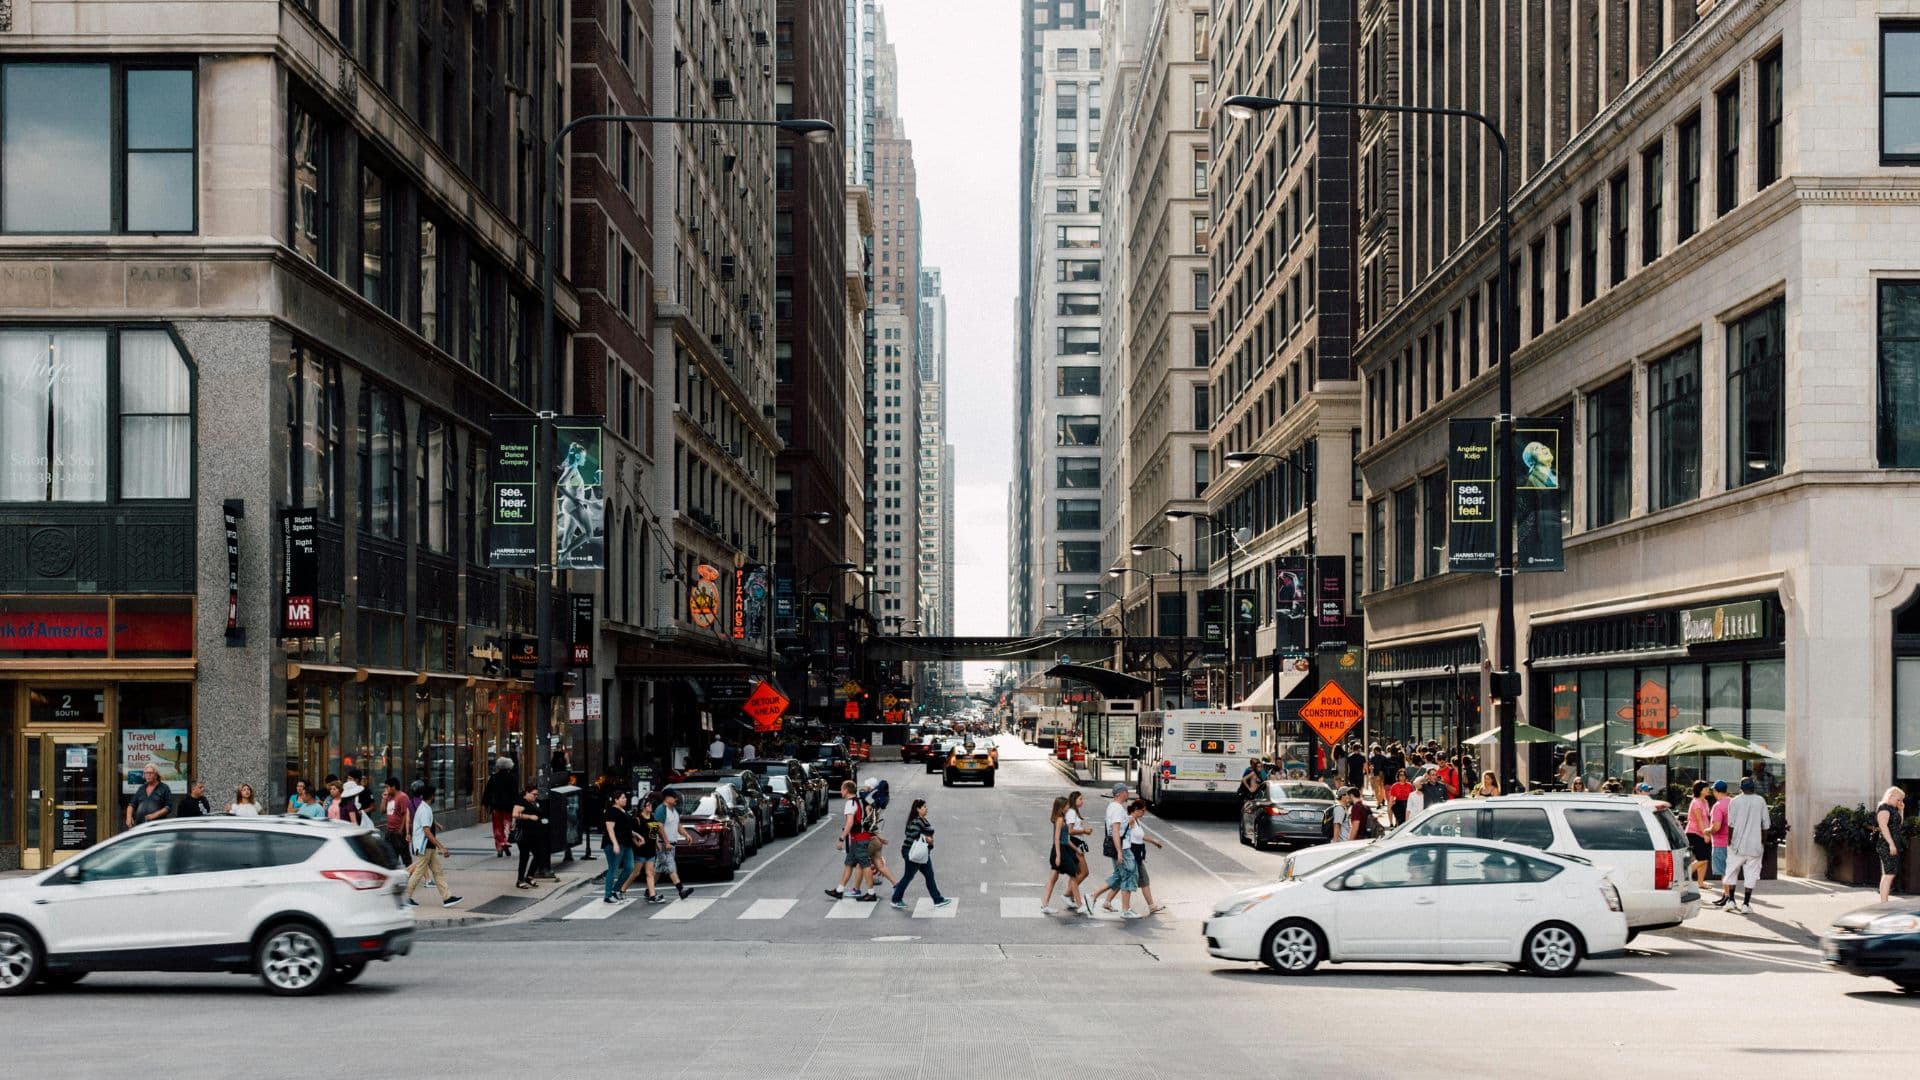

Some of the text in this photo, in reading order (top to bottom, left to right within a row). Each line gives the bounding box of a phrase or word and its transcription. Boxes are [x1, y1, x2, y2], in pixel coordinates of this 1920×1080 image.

[499, 458, 529, 466] Company
[500, 488, 524, 497] see.
[1458, 485, 1482, 494] see.
[500, 497, 527, 507] hear.
[1458, 495, 1486, 505] hear.
[500, 508, 524, 519] feel.
[1458, 506, 1482, 516] feel.
[294, 516, 313, 525] Right
[292, 524, 315, 532] Space.
[288, 605, 310, 620] MR
[18, 622, 34, 638] of
[37, 622, 104, 638] America
[575, 649, 588, 658] MR
[62, 694, 72, 709] 2
[751, 695, 780, 706] DETOUR
[1321, 697, 1342, 705] ROAD
[754, 706, 780, 715] AHEAD
[1304, 709, 1359, 717] CONSTRUCTION
[1319, 721, 1345, 729] AHEAD
[128, 731, 156, 741] Travel
[128, 743, 165, 751] without
[1207, 742, 1217, 750] 20
[128, 752, 151, 761] rules
